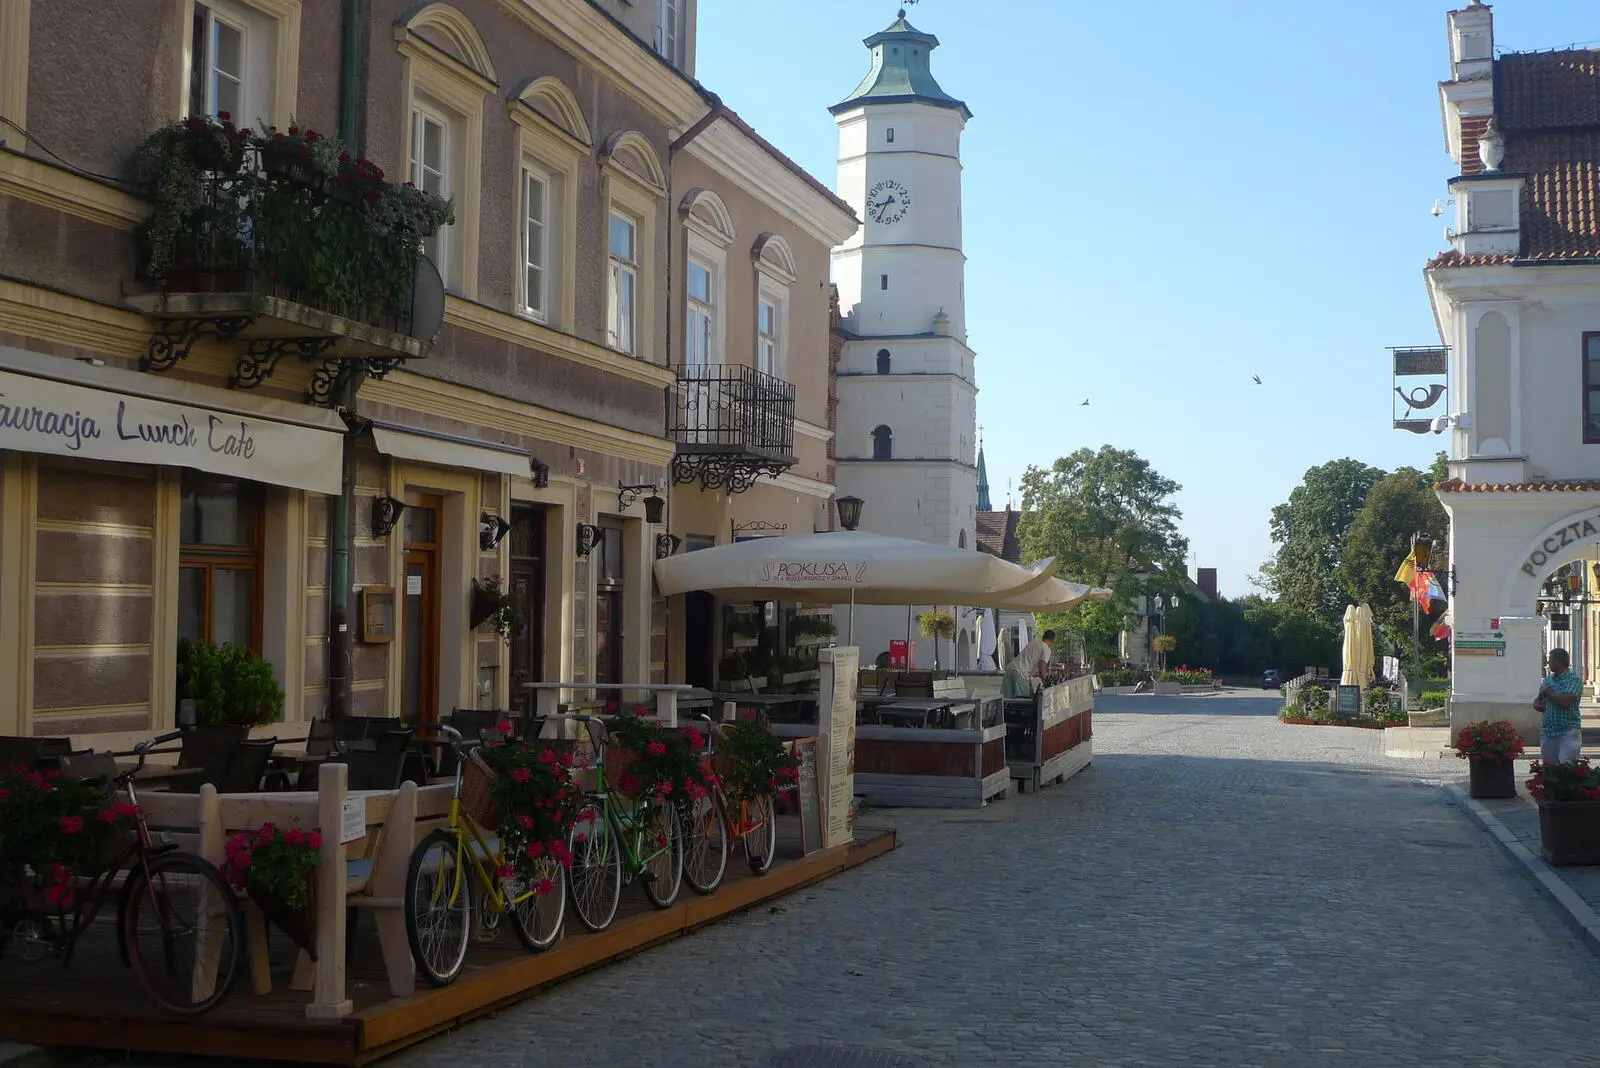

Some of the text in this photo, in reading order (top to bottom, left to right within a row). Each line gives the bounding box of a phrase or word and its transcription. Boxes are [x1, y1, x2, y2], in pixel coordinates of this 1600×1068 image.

[886, 180, 894, 188] 12
[0, 393, 101, 450] auracja
[117, 400, 198, 447] Lunch
[1521, 520, 1597, 577] POCZTA
[778, 562, 849, 576] POKUSA
